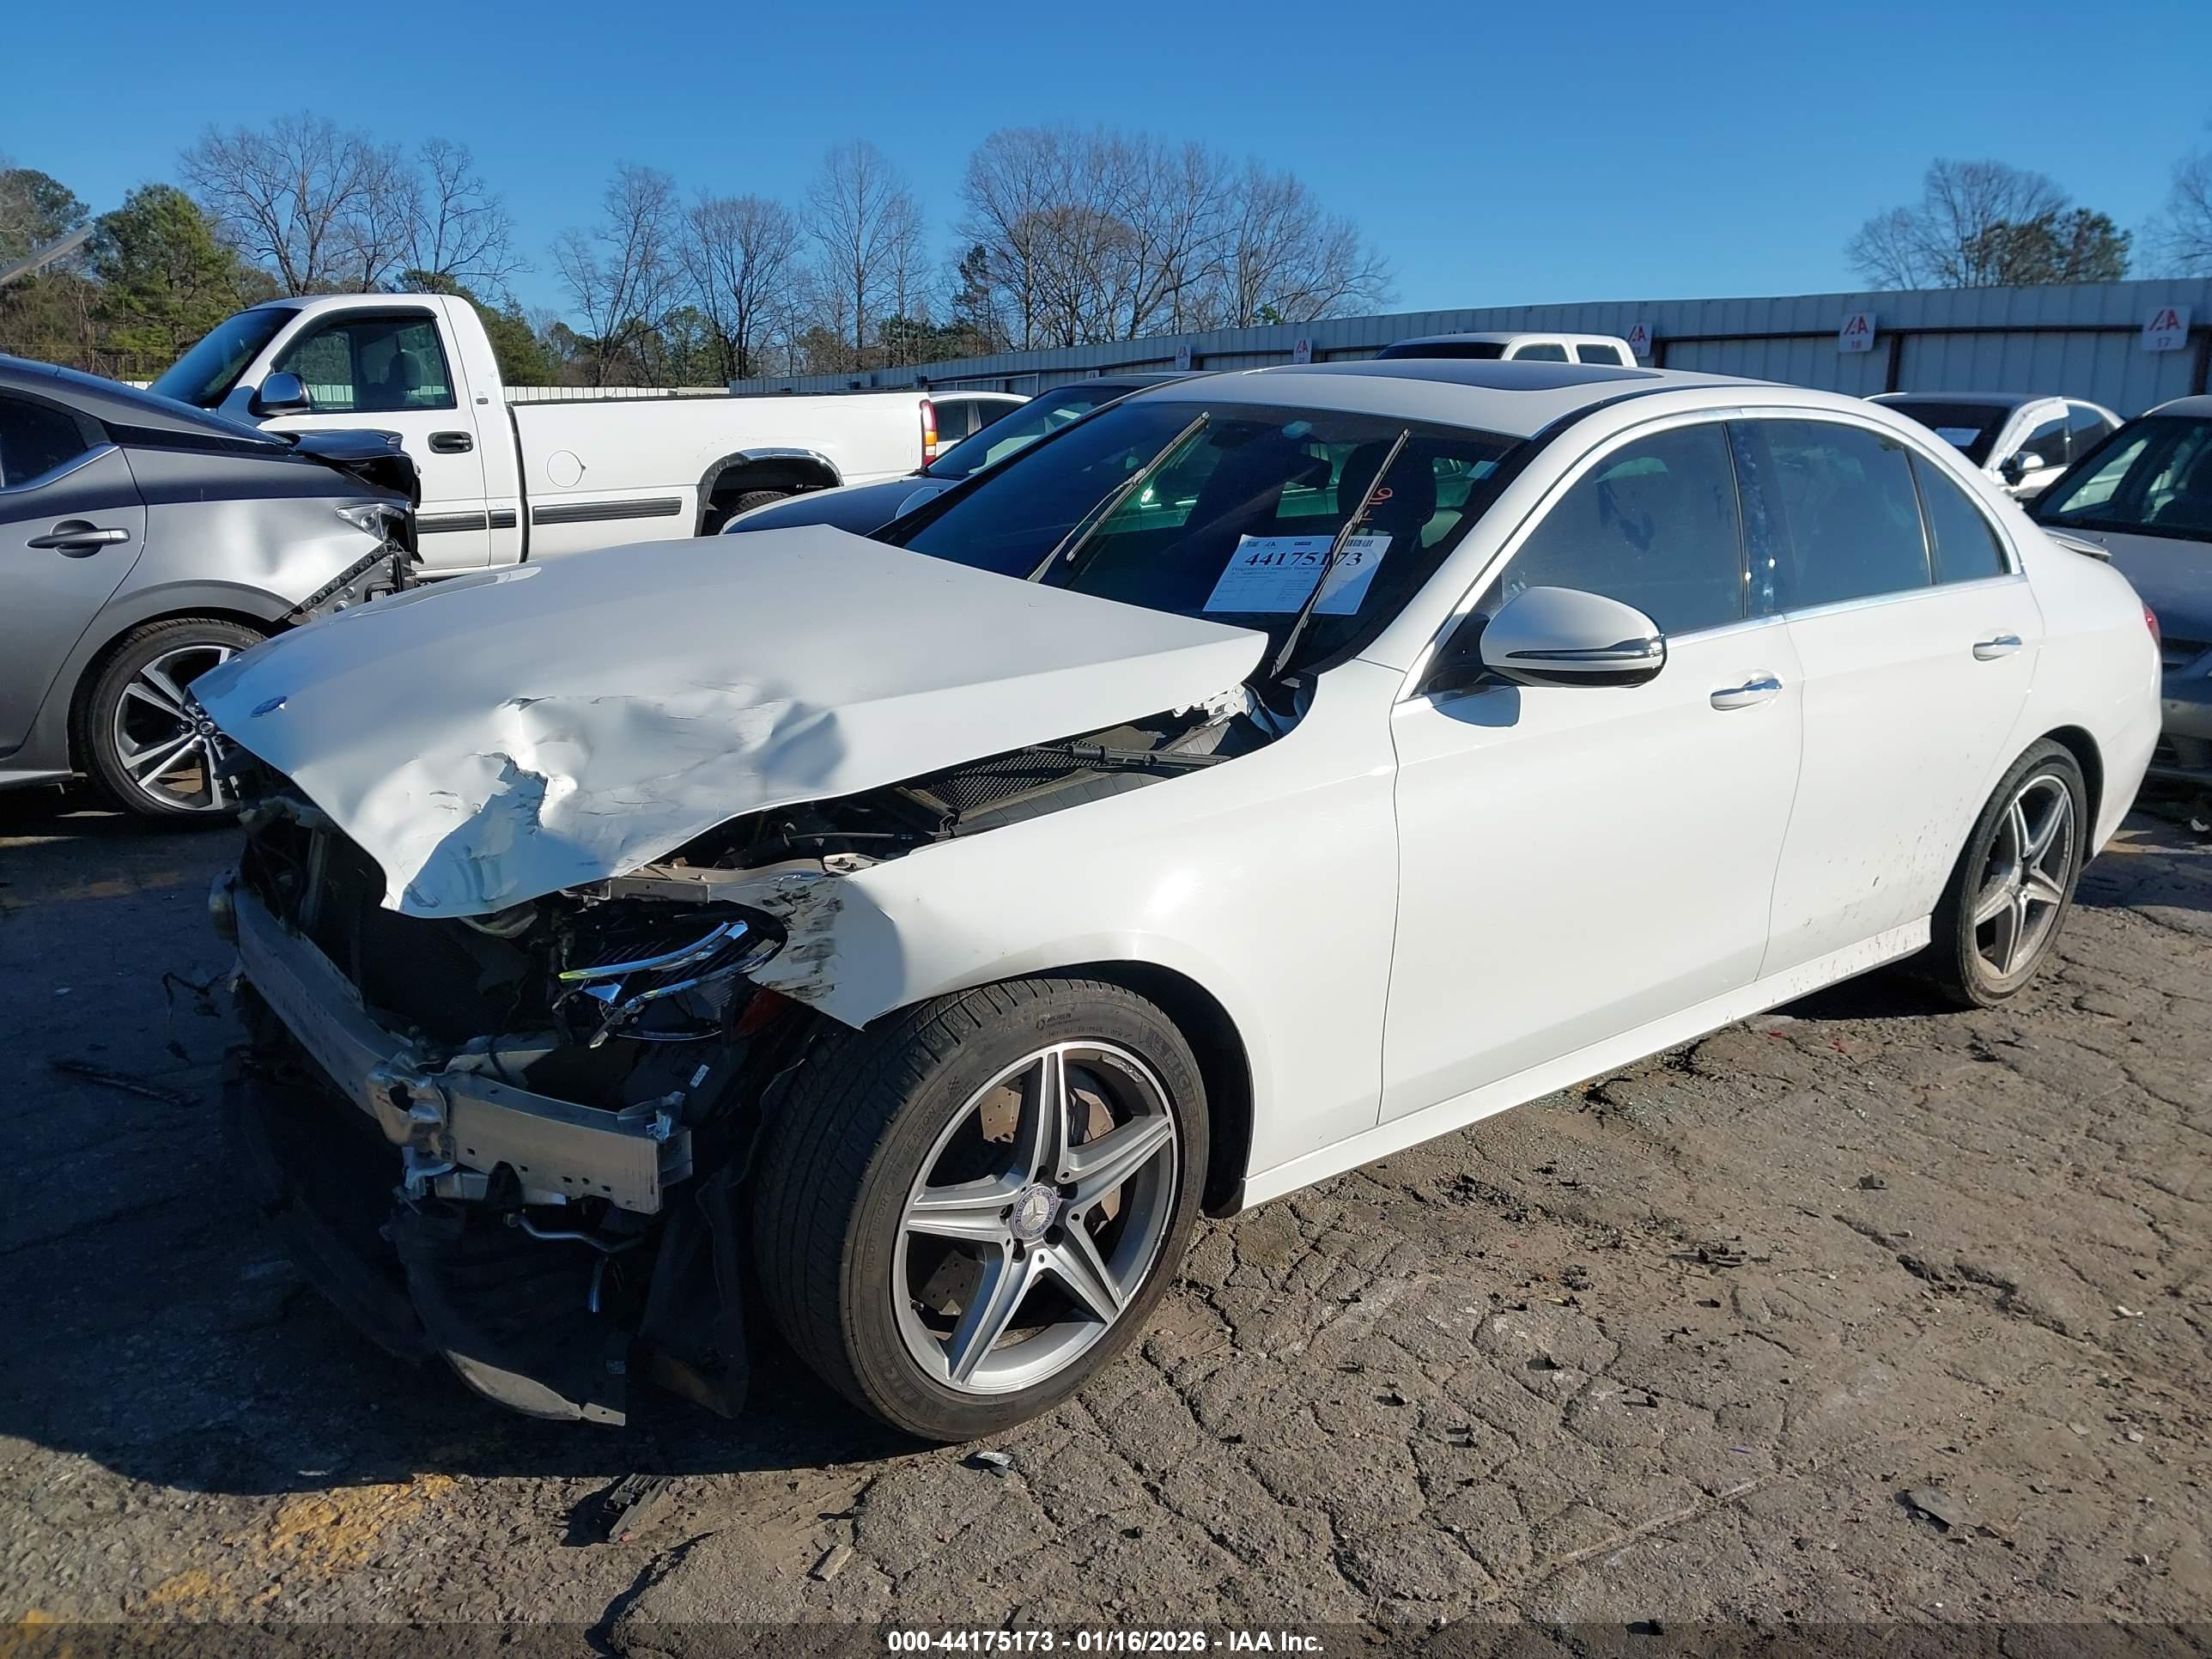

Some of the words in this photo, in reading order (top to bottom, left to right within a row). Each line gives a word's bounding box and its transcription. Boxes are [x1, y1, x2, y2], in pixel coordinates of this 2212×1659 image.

[2157, 337, 2172, 347] 17
[1244, 550, 1363, 566] 44175173
[901, 1106, 937, 1156] SEASON
